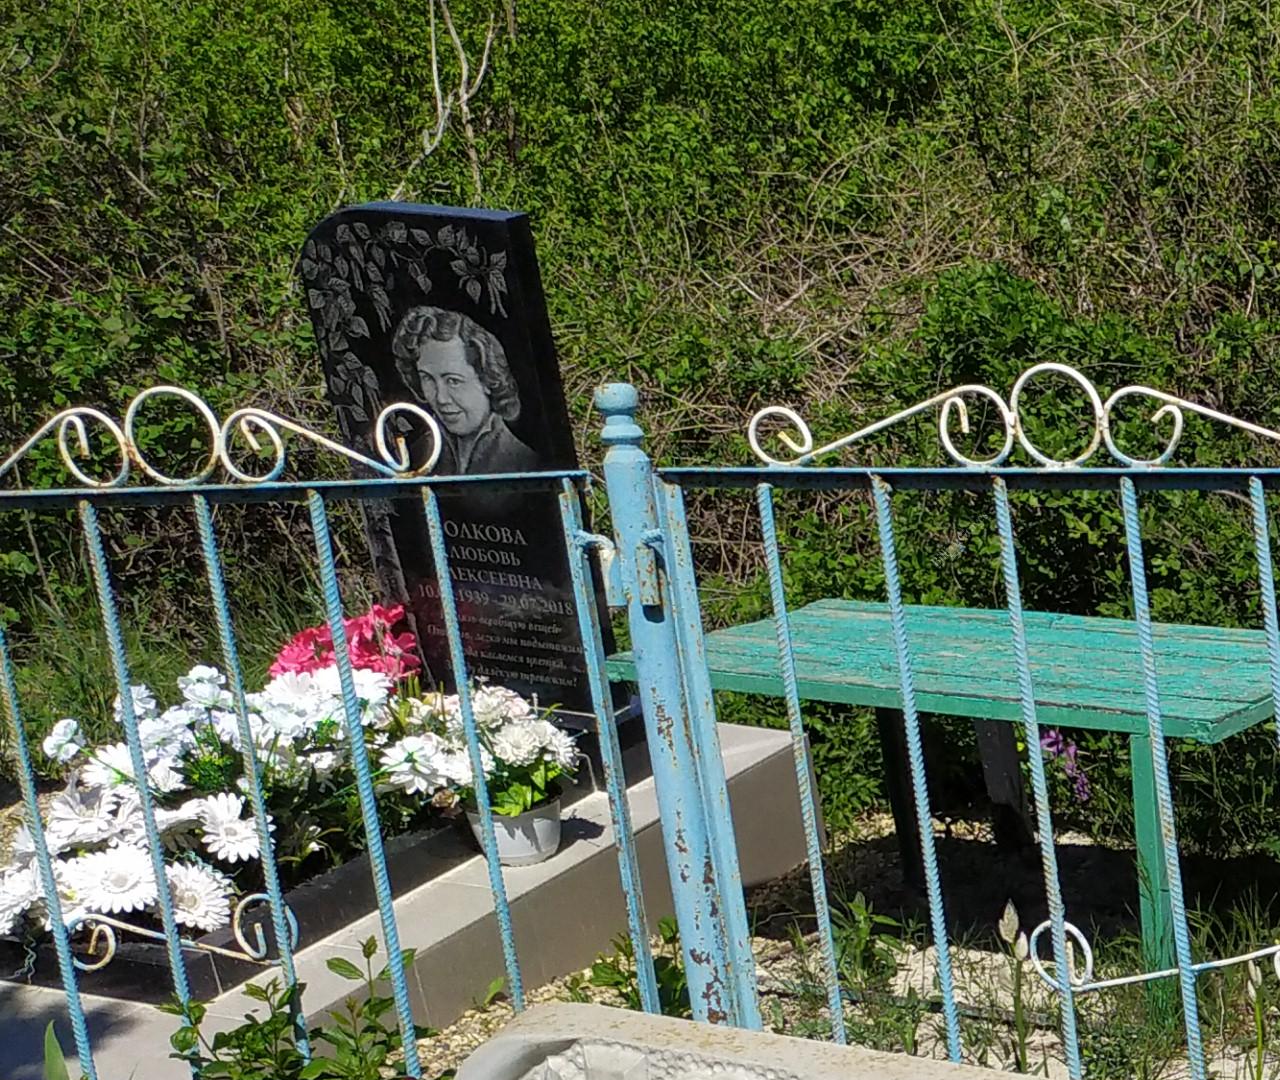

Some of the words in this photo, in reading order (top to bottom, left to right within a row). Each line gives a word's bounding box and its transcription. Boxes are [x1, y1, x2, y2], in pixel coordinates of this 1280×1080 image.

[443, 519, 528, 546] ОЛКОВА
[450, 545, 521, 567] ЛЮБОВЬ
[449, 566, 543, 591] ЛЕКСЕЕВНА
